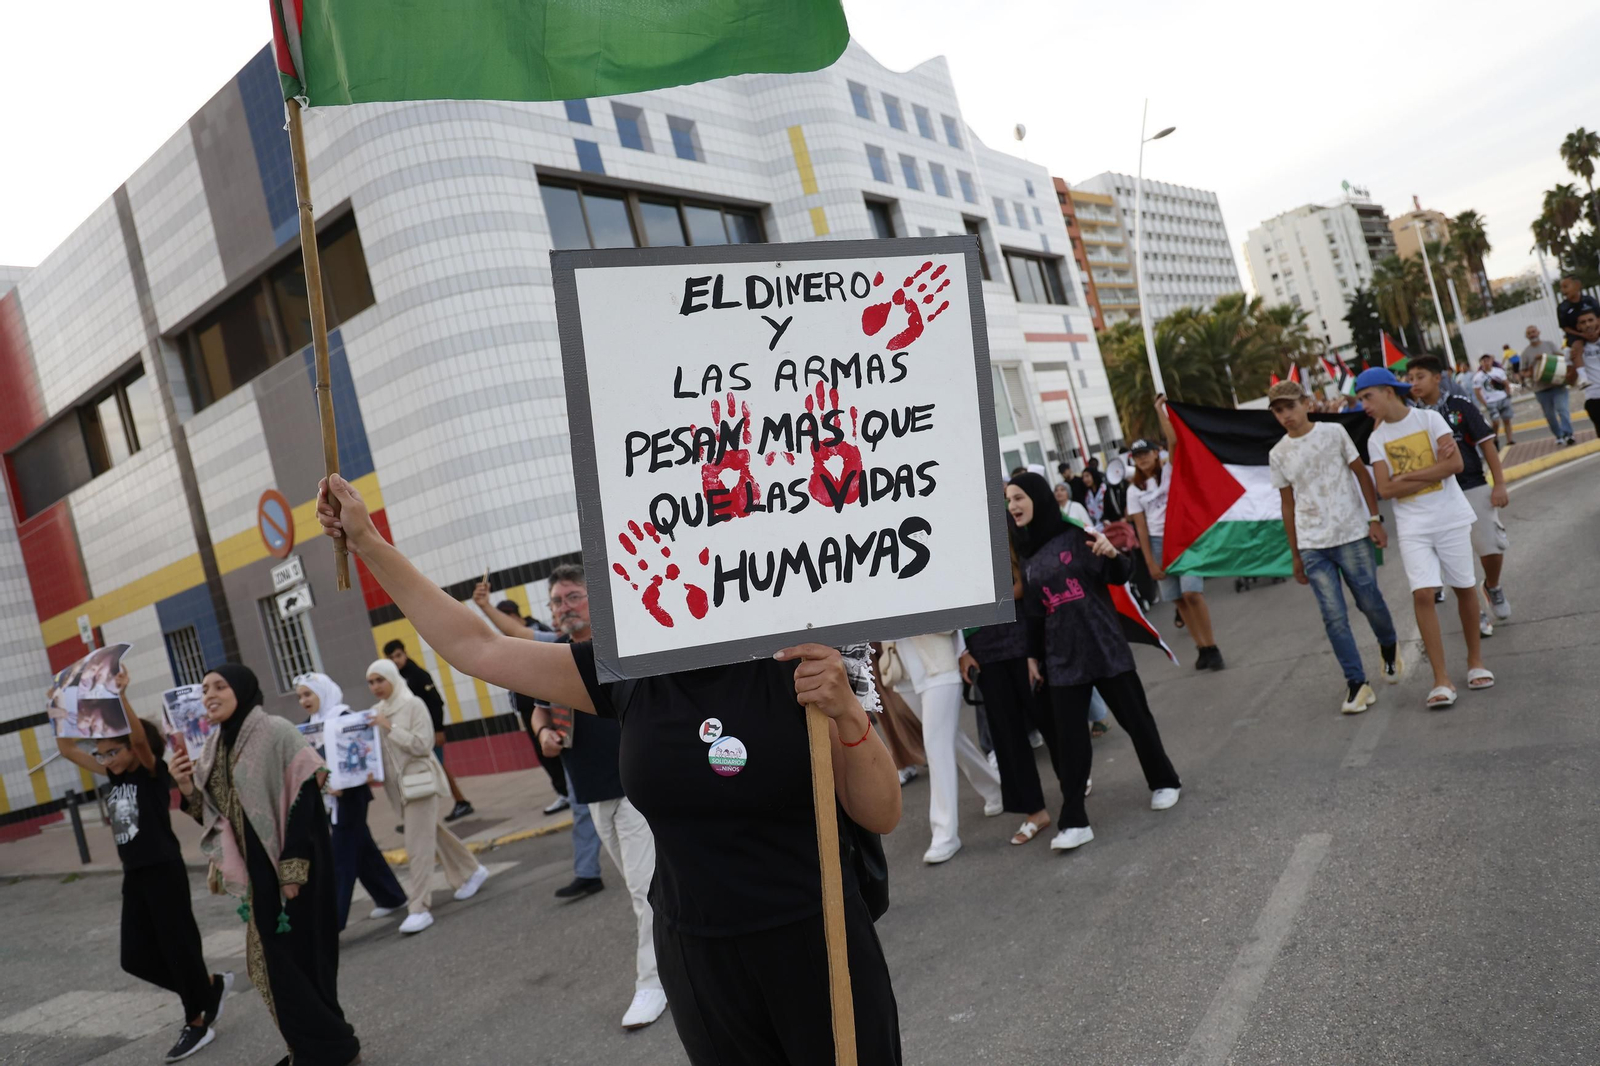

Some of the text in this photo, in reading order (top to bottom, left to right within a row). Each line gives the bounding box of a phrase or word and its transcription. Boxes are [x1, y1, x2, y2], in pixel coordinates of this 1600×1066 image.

[680, 271, 873, 316] EL DINERO
[761, 315, 792, 351] Y
[673, 352, 909, 399] LAS ARMAS
[625, 403, 936, 478] PESAN MAS QUE
[649, 460, 940, 542] QUE LAS VIDAS
[713, 516, 932, 608] HUMANAS
[711, 758, 744, 766] SOLIDARIOS
